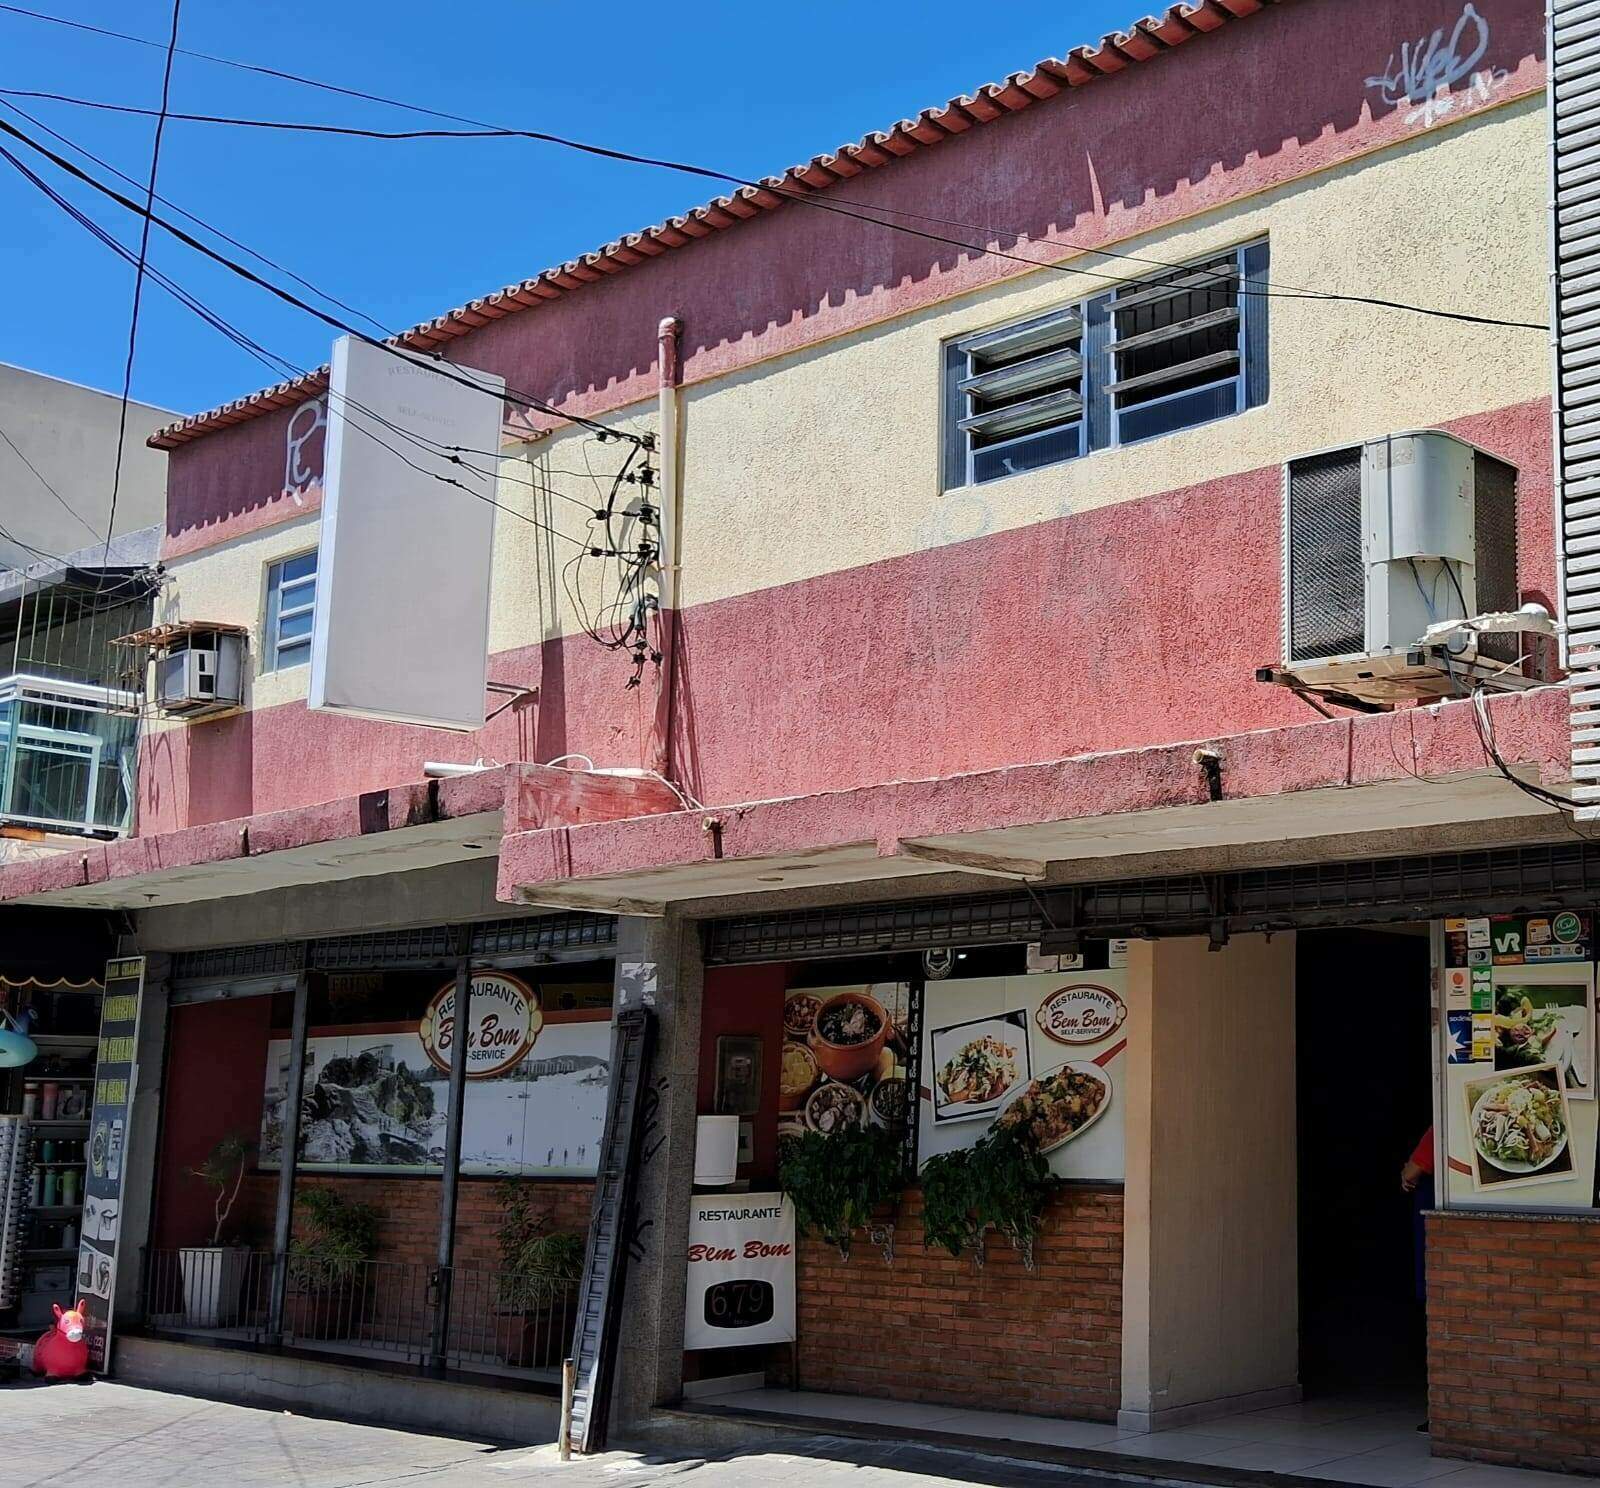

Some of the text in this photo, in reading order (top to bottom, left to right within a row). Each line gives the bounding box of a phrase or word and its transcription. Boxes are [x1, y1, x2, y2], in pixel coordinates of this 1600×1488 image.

[1050, 991, 1113, 1011] RESTAURANTE
[1051, 1008, 1112, 1028] Bem Bom
[438, 1013, 521, 1050] Bm Bom
[1060, 1028, 1101, 1036] SELF-SERVICE
[699, 1207, 781, 1222] RESTAURANTE
[688, 1240, 791, 1262] Bem Bom
